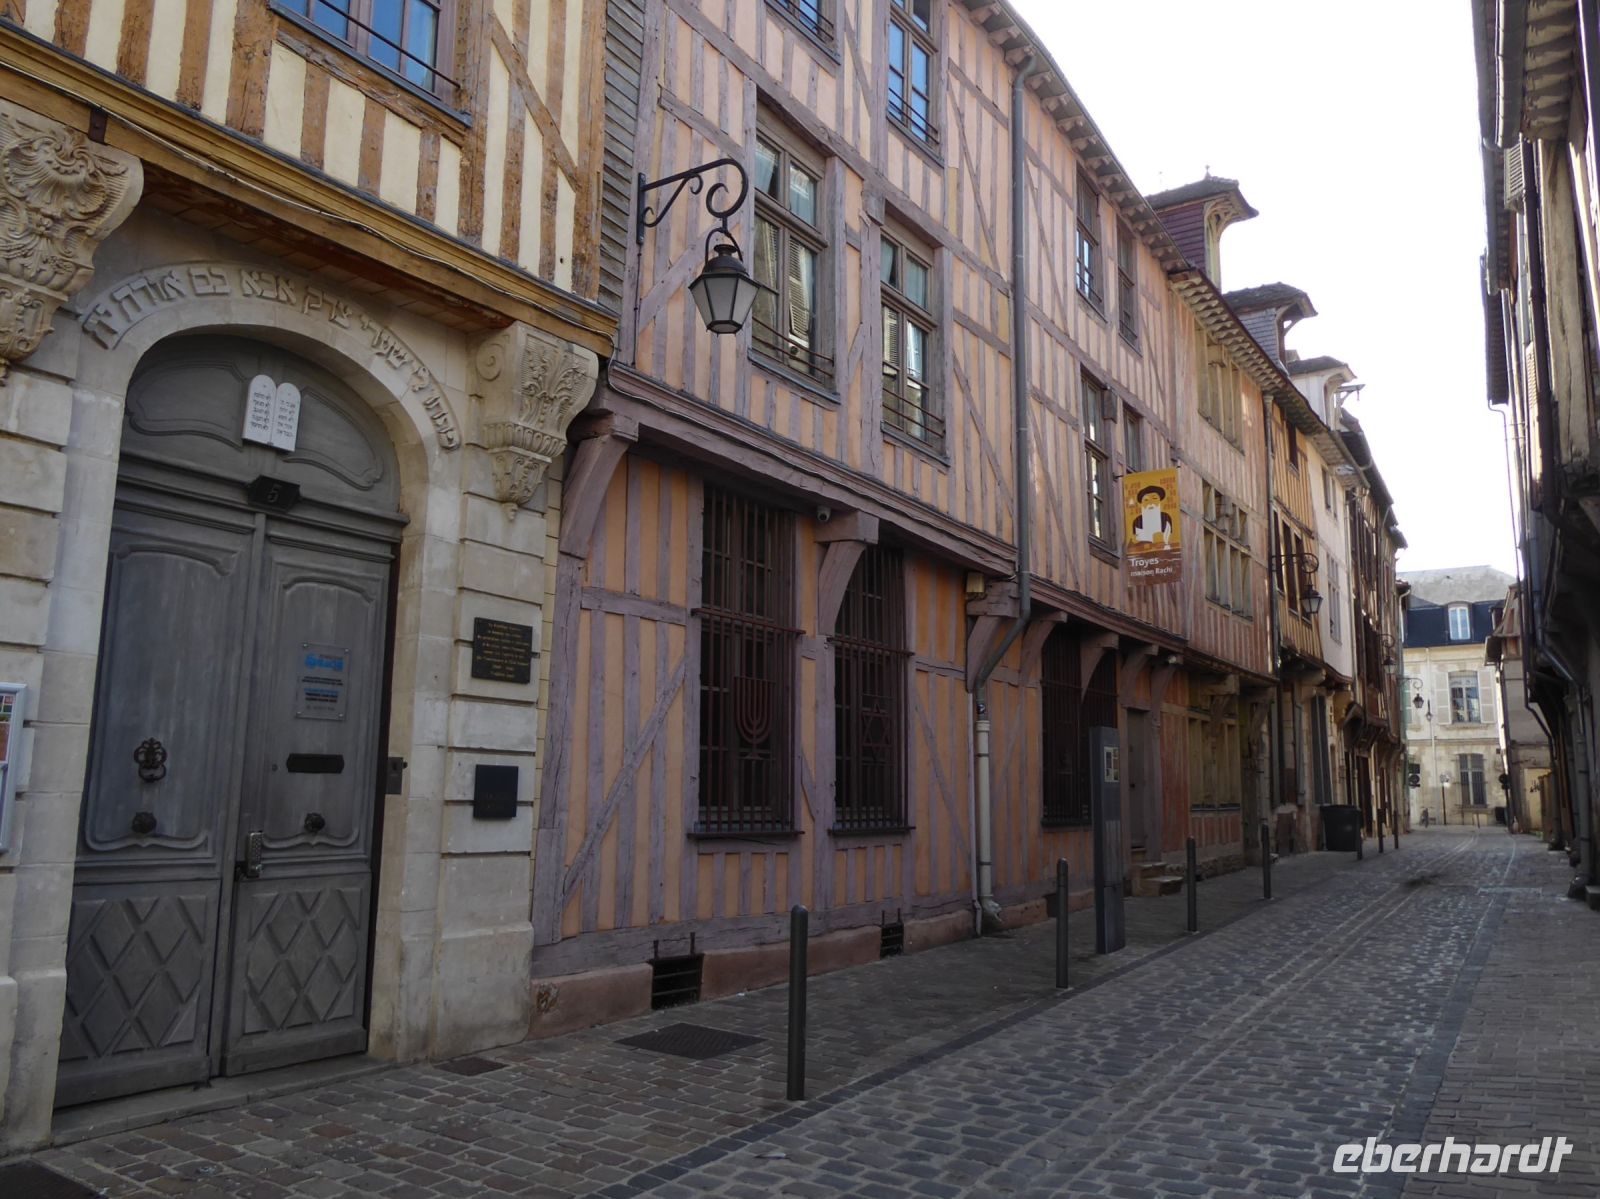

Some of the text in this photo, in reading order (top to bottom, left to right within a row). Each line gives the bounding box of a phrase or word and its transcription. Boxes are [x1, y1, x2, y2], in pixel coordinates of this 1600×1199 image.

[188, 266, 231, 297] בם
[240, 269, 297, 306] אבא
[267, 483, 282, 503] 5
[1131, 558, 1159, 568] Troyes
[1156, 566, 1172, 574] Rachi
